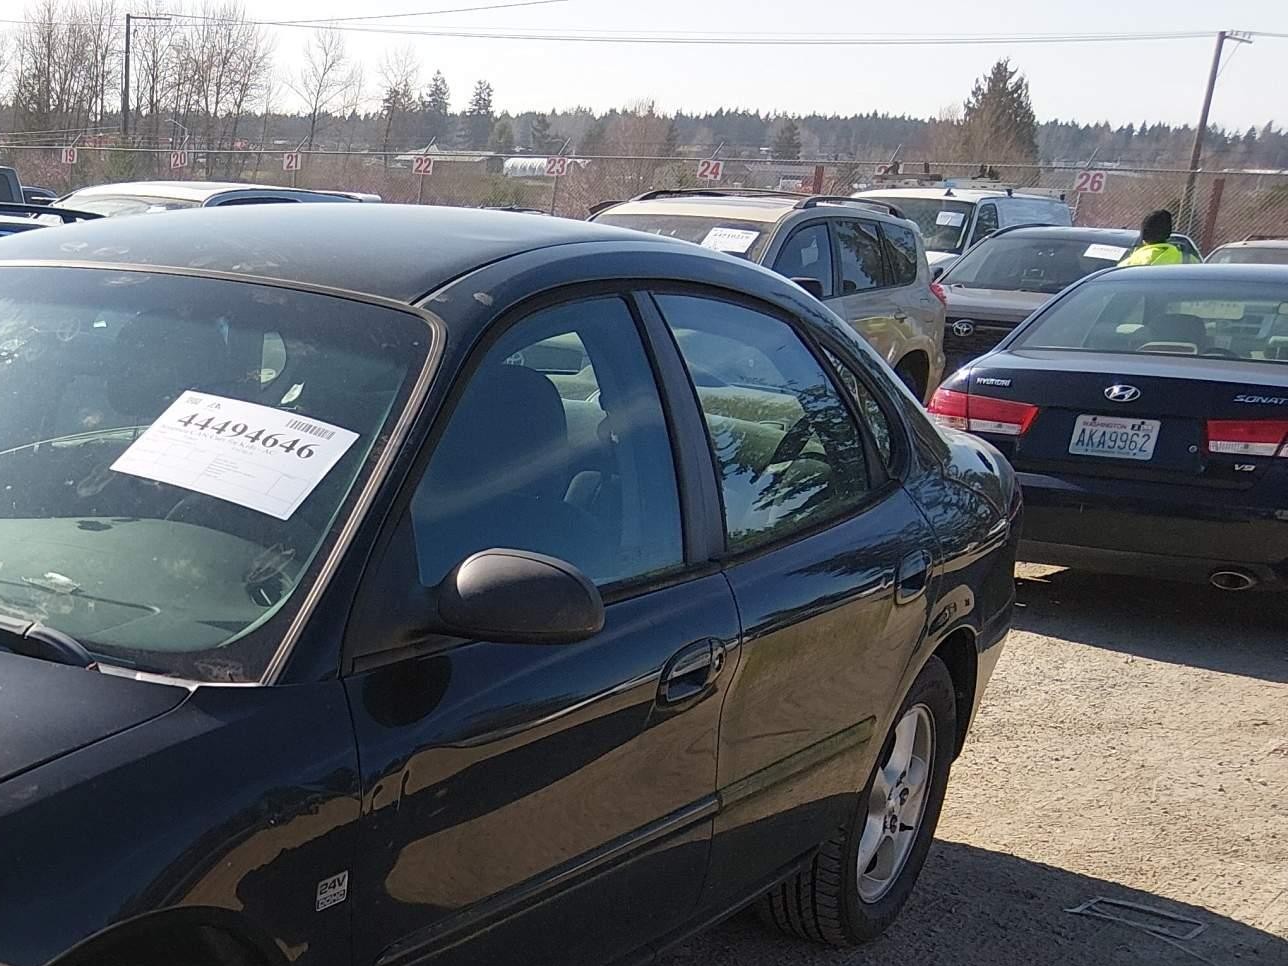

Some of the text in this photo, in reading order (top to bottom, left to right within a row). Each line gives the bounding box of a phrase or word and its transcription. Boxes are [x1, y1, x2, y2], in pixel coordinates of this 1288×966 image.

[65, 148, 74, 162] 19
[172, 151, 186, 168] 20
[286, 154, 299, 168] 21
[415, 157, 432, 174] 22
[547, 157, 565, 175] 23
[698, 161, 721, 179] 24
[1077, 172, 1104, 192] 26
[976, 377, 1011, 387] HYUNDAI
[1082, 420, 1127, 430] WASHINGTON
[178, 413, 320, 459] 44494646
[1075, 428, 1151, 453] AKA9962
[318, 874, 346, 895] 24V
